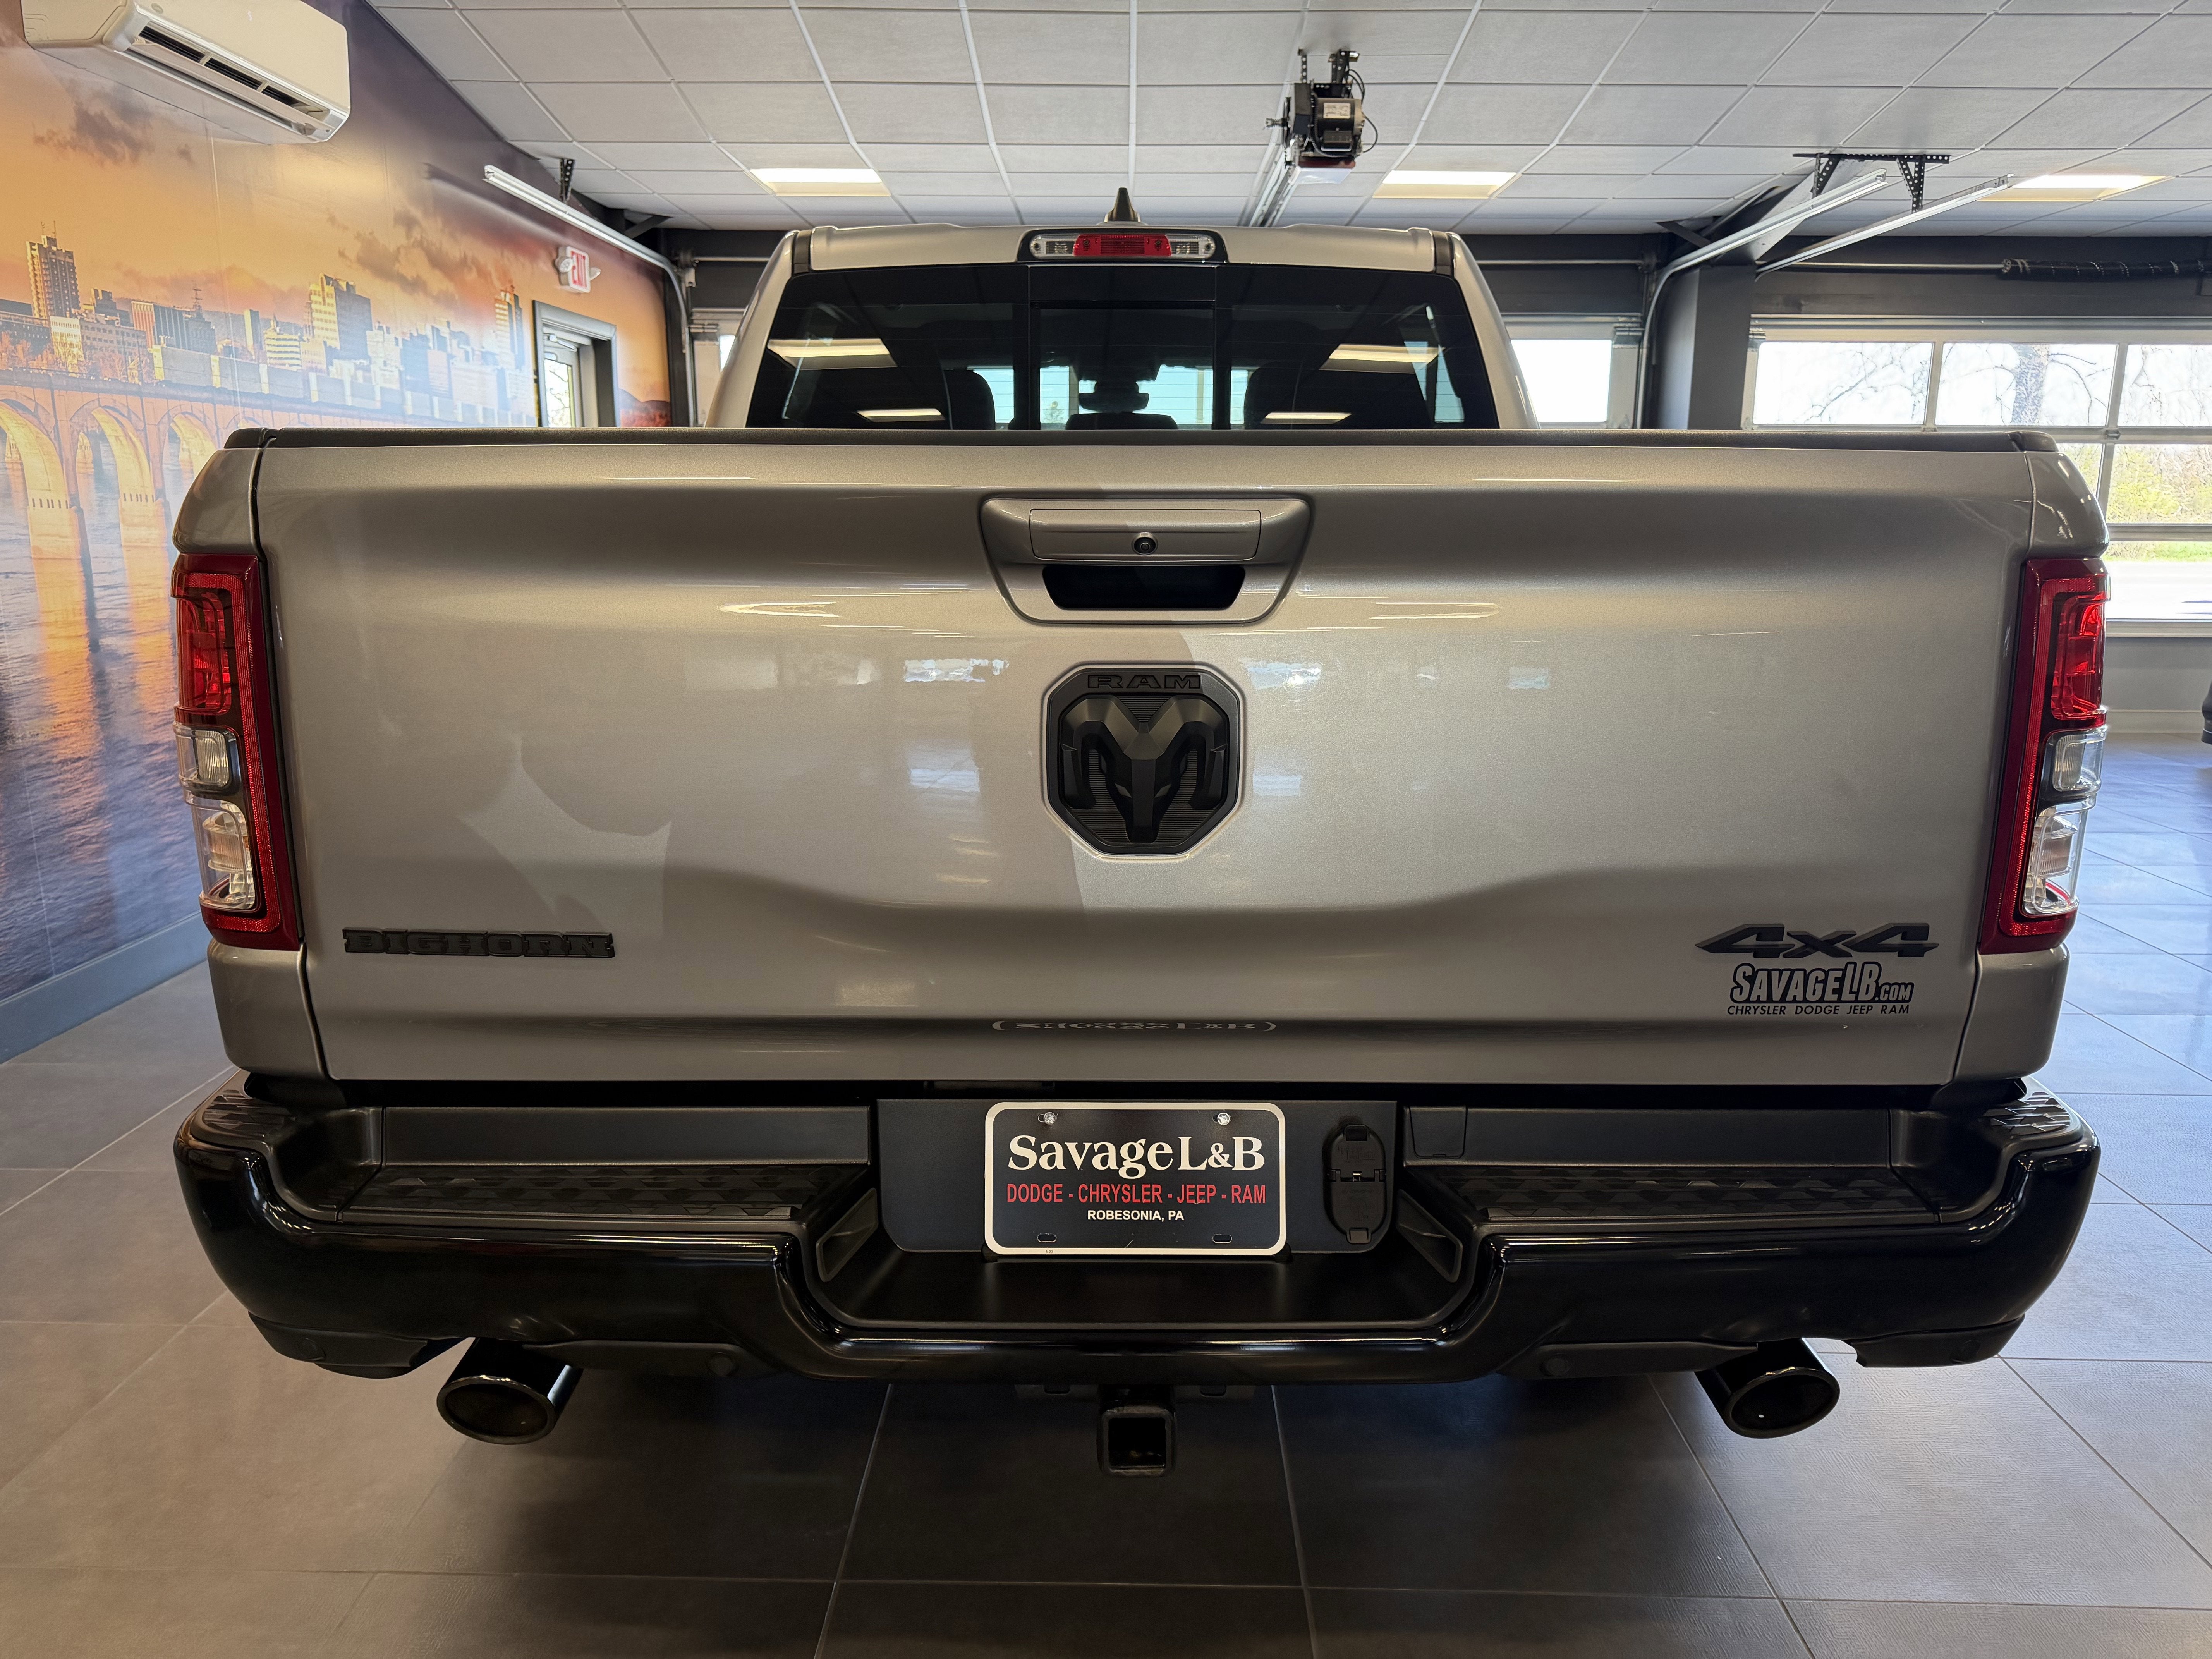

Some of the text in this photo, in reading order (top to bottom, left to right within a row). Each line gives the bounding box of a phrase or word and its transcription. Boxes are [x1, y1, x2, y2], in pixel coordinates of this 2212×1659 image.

[1088, 675, 1201, 689] RAM
[342, 927, 615, 958] BIGHORN
[1727, 1005, 1909, 1015] CHRYSLER DODGE JEEP RAM
[1008, 1135, 1265, 1179] Savage L&B
[1007, 1184, 1063, 1202] DODGE
[1078, 1184, 1163, 1203] CHRYSLER
[1177, 1185, 1216, 1204] JEEP
[1231, 1185, 1266, 1204] RAM
[1087, 1210, 1184, 1222] ROBESONIA, PA
